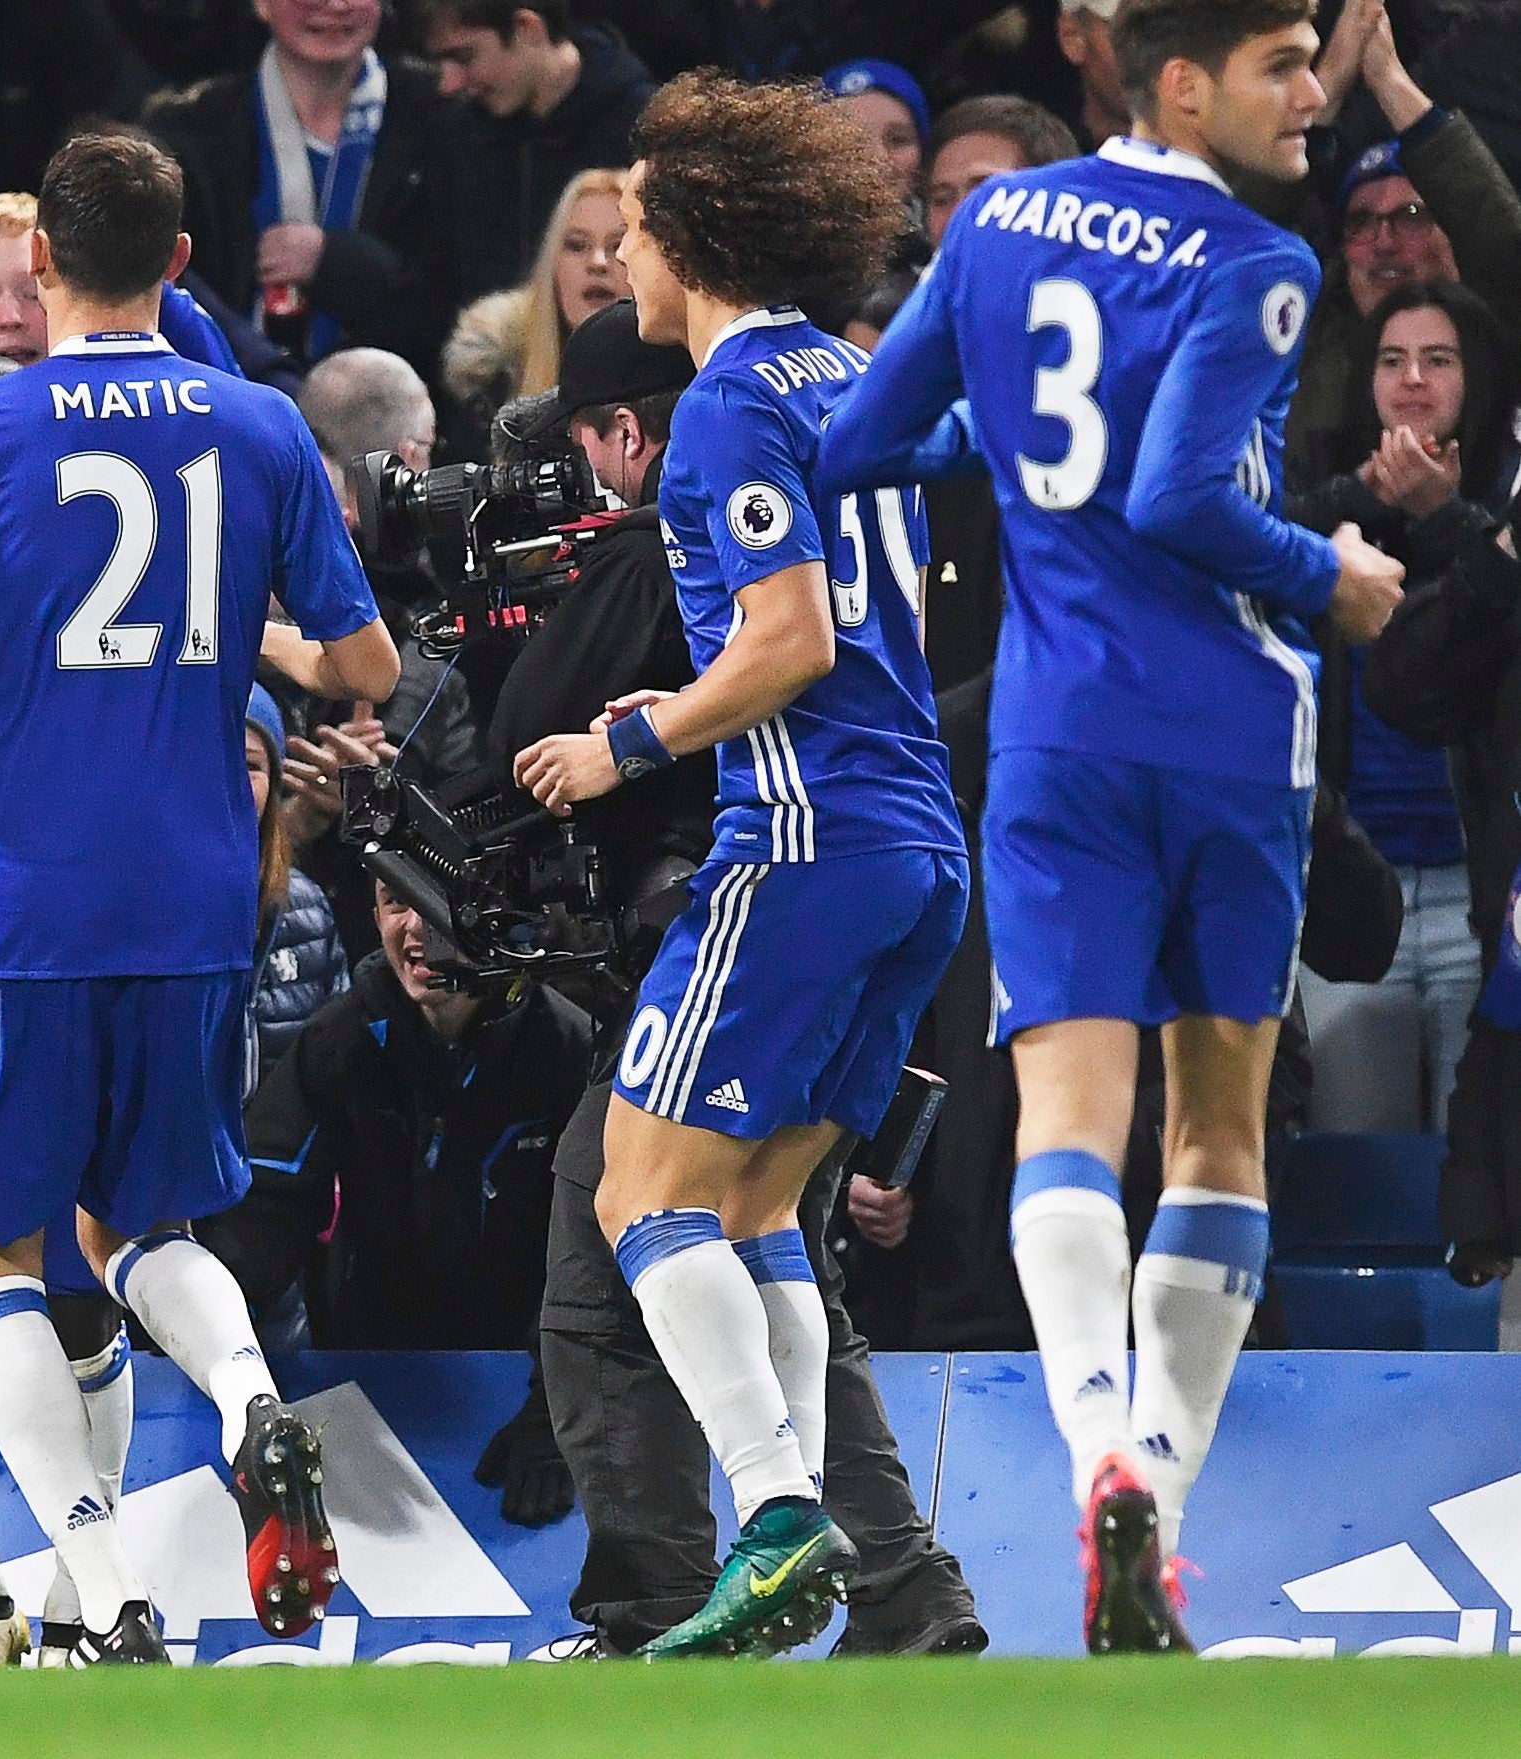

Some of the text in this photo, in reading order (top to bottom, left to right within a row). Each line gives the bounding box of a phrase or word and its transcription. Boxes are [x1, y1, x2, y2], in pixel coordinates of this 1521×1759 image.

[975, 187, 1208, 268] MARCOS A.
[49, 379, 212, 420] MATIC
[752, 347, 847, 396] DAVID
[1015, 276, 1109, 512] 3
[56, 447, 222, 669] 21
[705, 1094, 750, 1114] adidas
